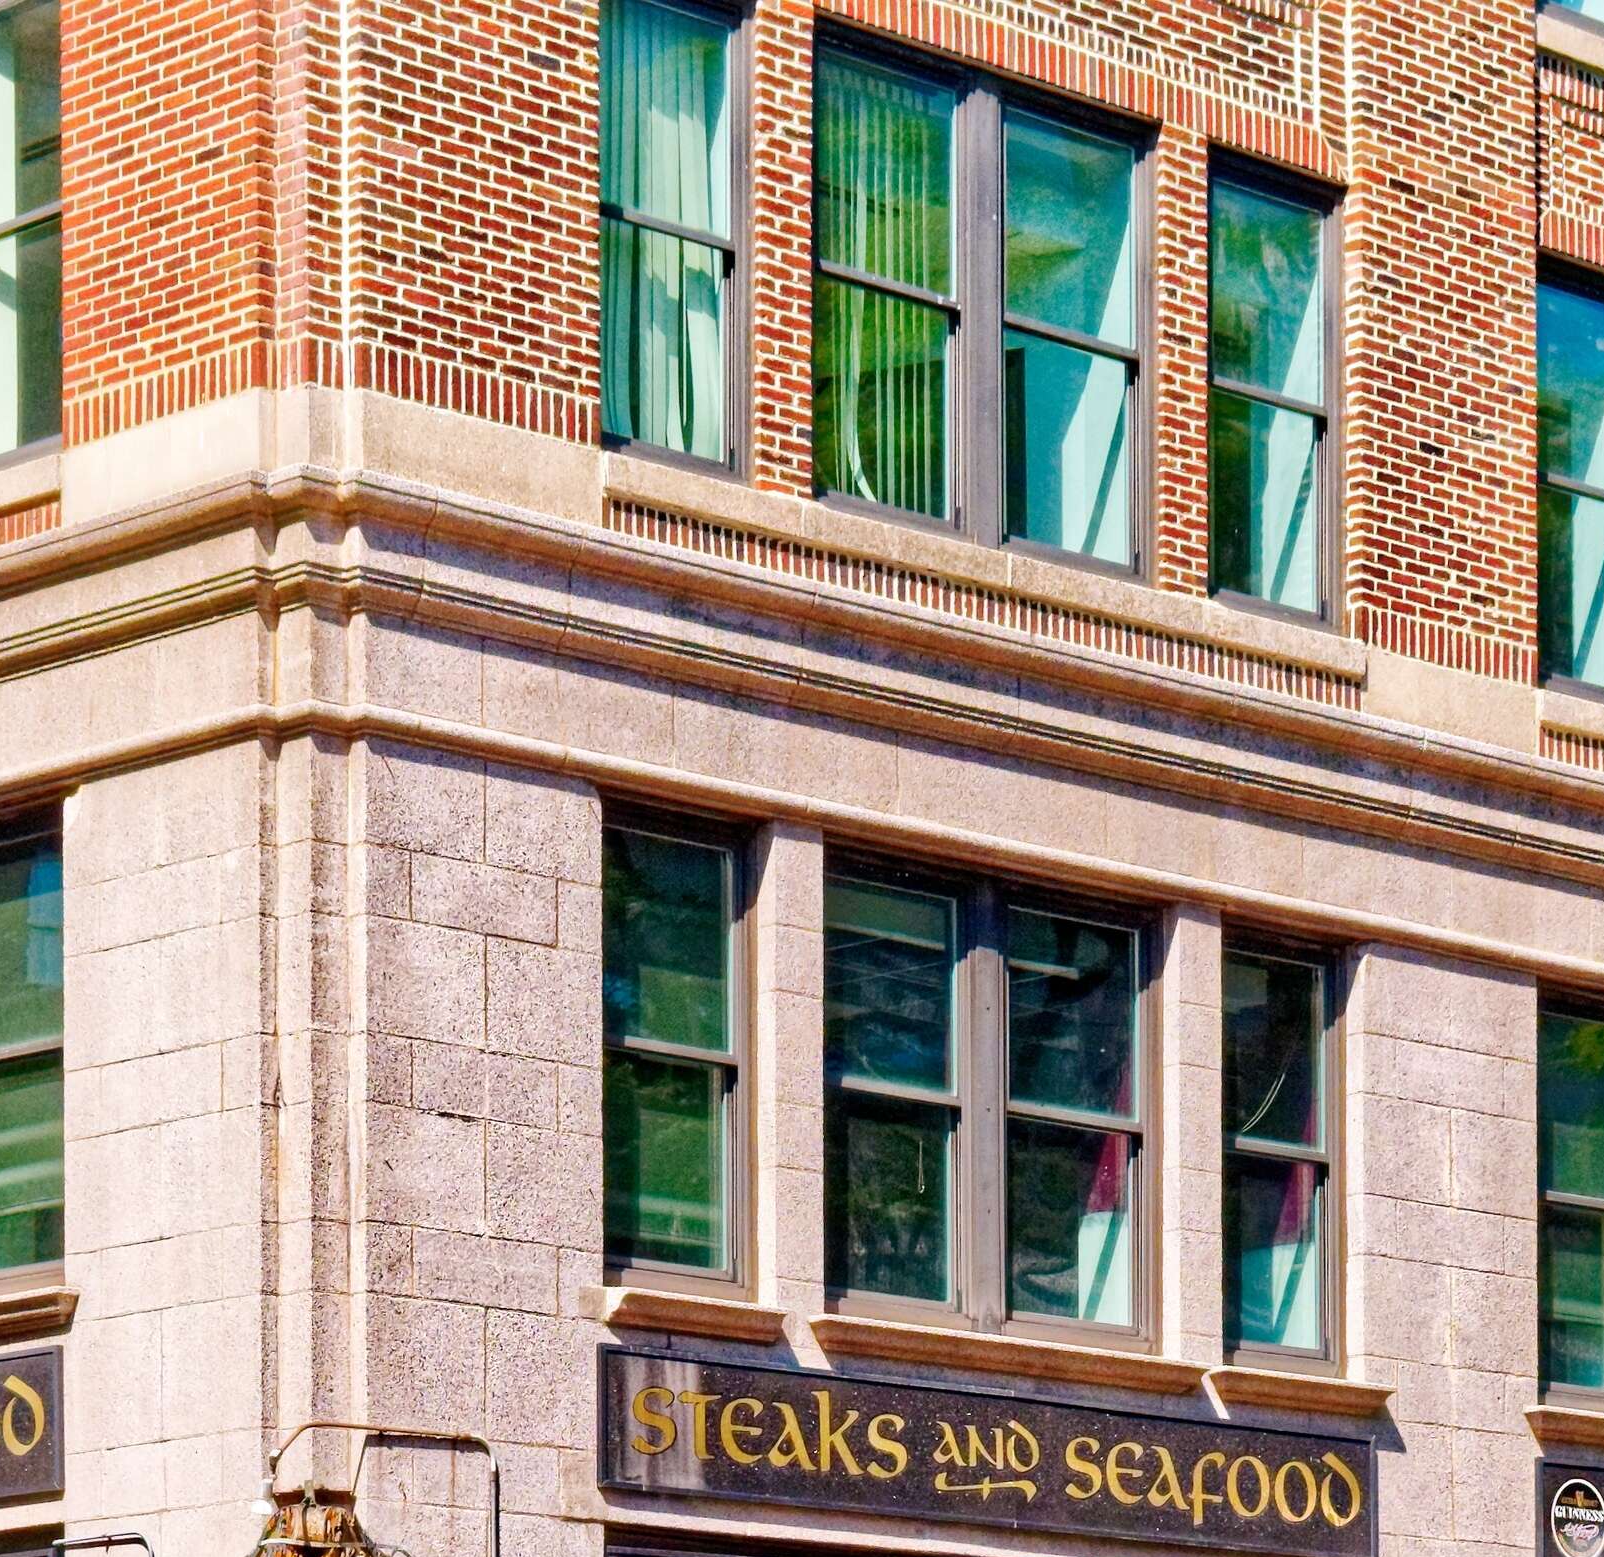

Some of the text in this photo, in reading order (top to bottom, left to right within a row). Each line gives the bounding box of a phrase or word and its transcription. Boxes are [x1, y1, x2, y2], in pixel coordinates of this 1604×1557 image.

[631, 1386, 1363, 1527] STEAKS AND SEAFOOD
